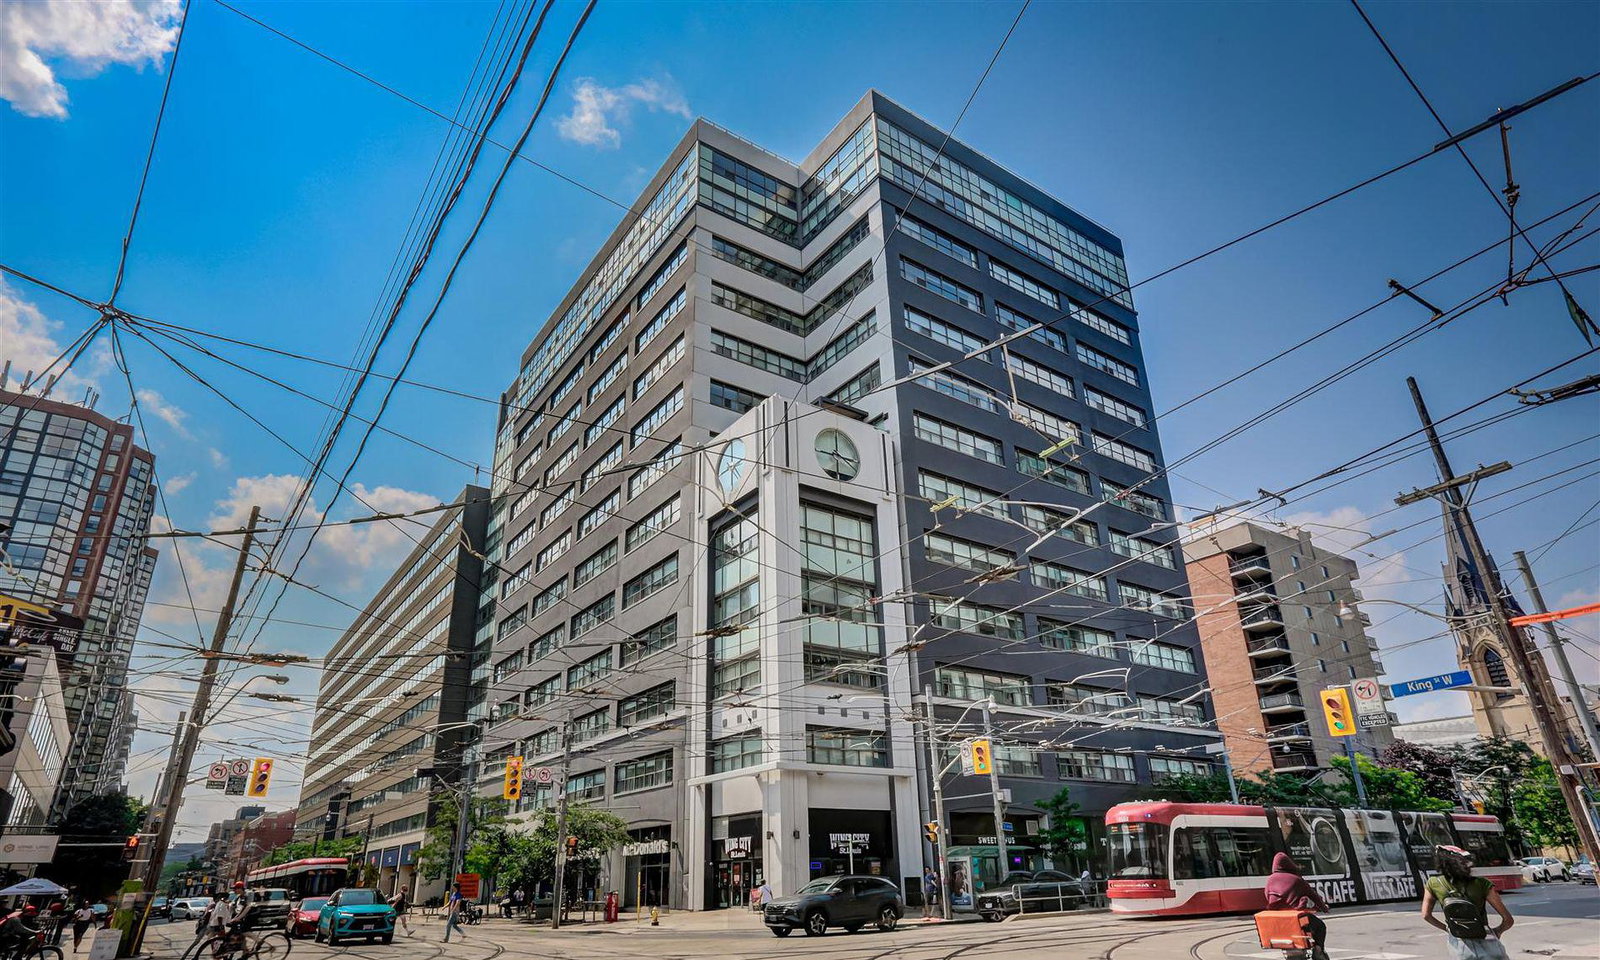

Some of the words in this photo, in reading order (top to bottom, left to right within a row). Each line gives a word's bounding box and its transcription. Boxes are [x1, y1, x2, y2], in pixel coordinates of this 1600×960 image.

[1407, 681, 1433, 692] King
[1441, 674, 1452, 685] W
[978, 836, 997, 844] SWEET
